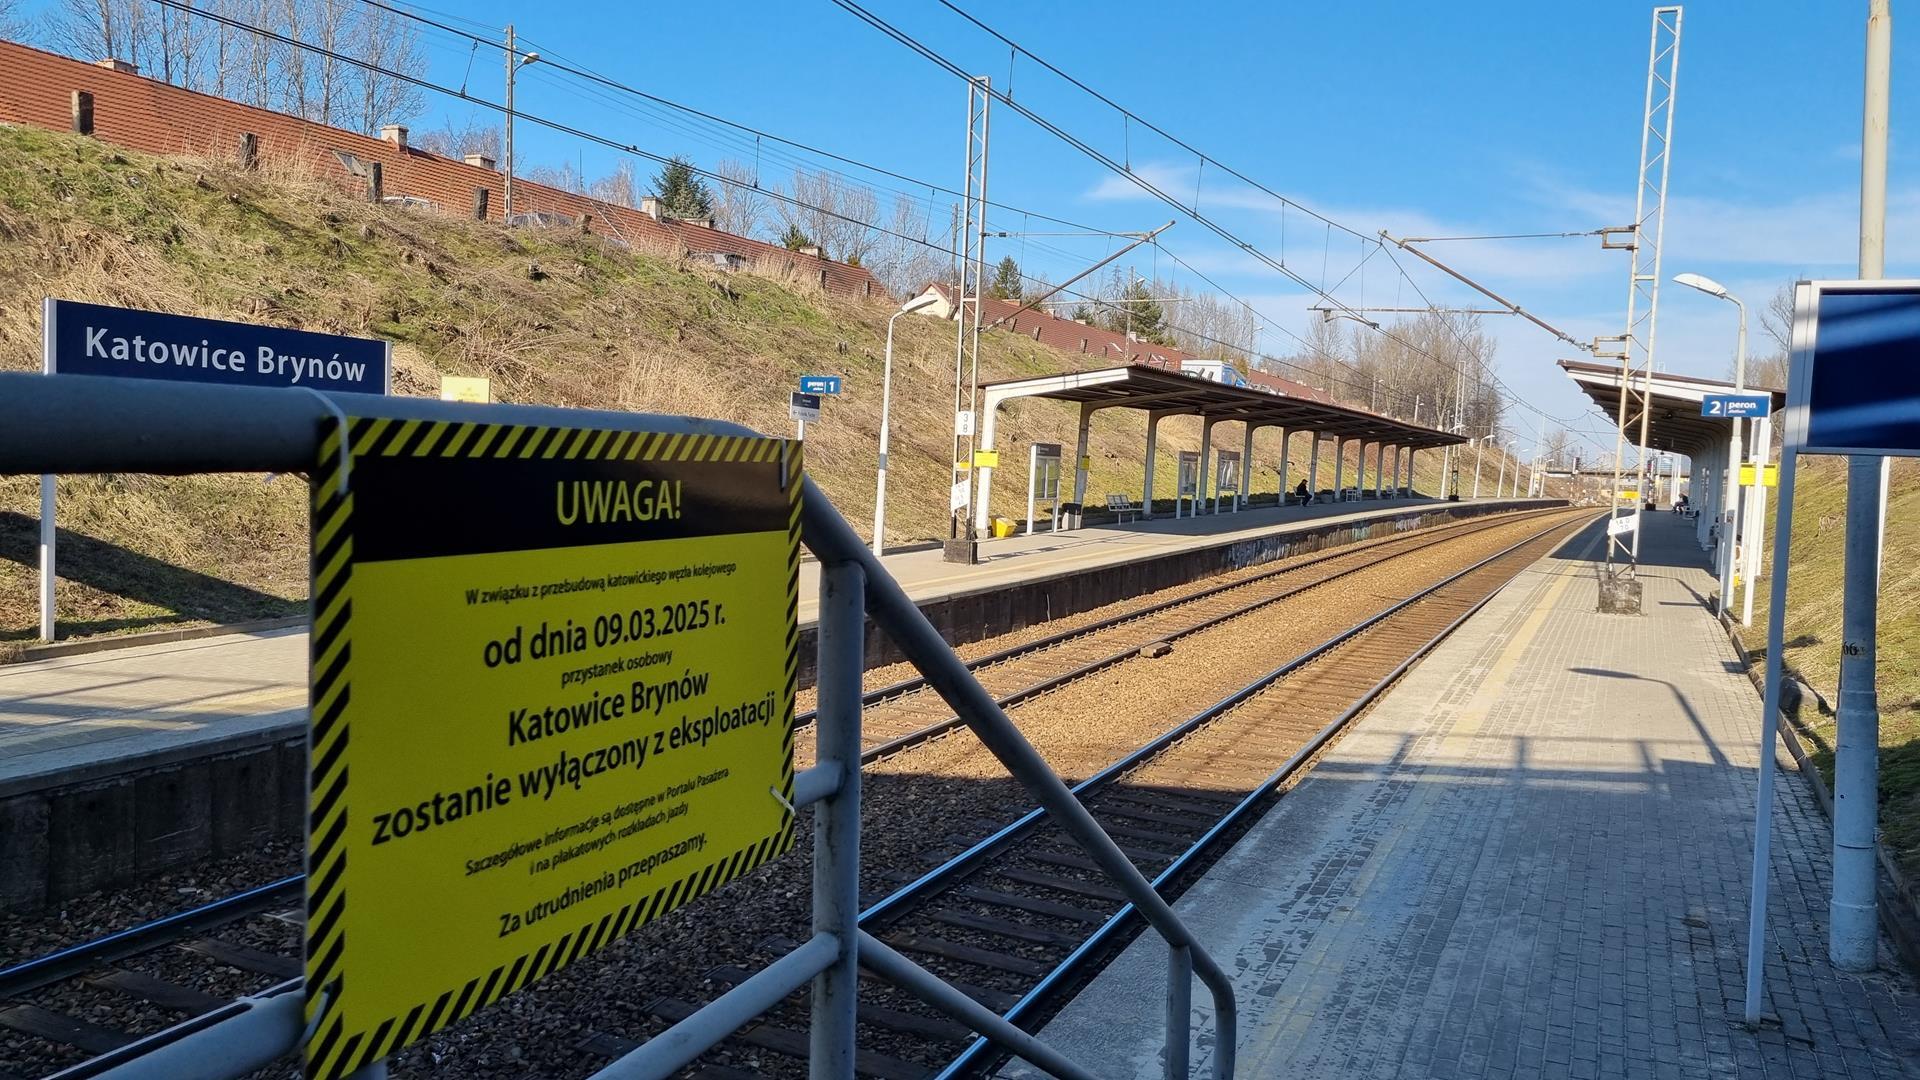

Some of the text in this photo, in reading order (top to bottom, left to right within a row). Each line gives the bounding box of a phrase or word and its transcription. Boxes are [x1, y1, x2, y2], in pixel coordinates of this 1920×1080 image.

[85, 326, 366, 384] Katowice Brynów
[830, 381, 835, 392] 1
[1709, 400, 1721, 414] 2
[1728, 401, 1757, 410] peron
[556, 479, 682, 525] UWAGA!
[465, 562, 737, 604] W związku z przebudową katowickiego węzła kolejowego
[484, 600, 726, 668] od dnia 09.03.2025 r.
[561, 650, 673, 689] przystanek osobowy
[508, 668, 710, 746] Katowice Brynów
[371, 691, 776, 846] zostanie wyłączony z eksploatacji
[464, 768, 730, 877] Szczegółowe informacje są dostępne w Portalu Pasażera
[529, 801, 689, 875] i na plakatowych rozkładach jazdy
[498, 832, 708, 938] Za utrudnienia przepraszamy.
